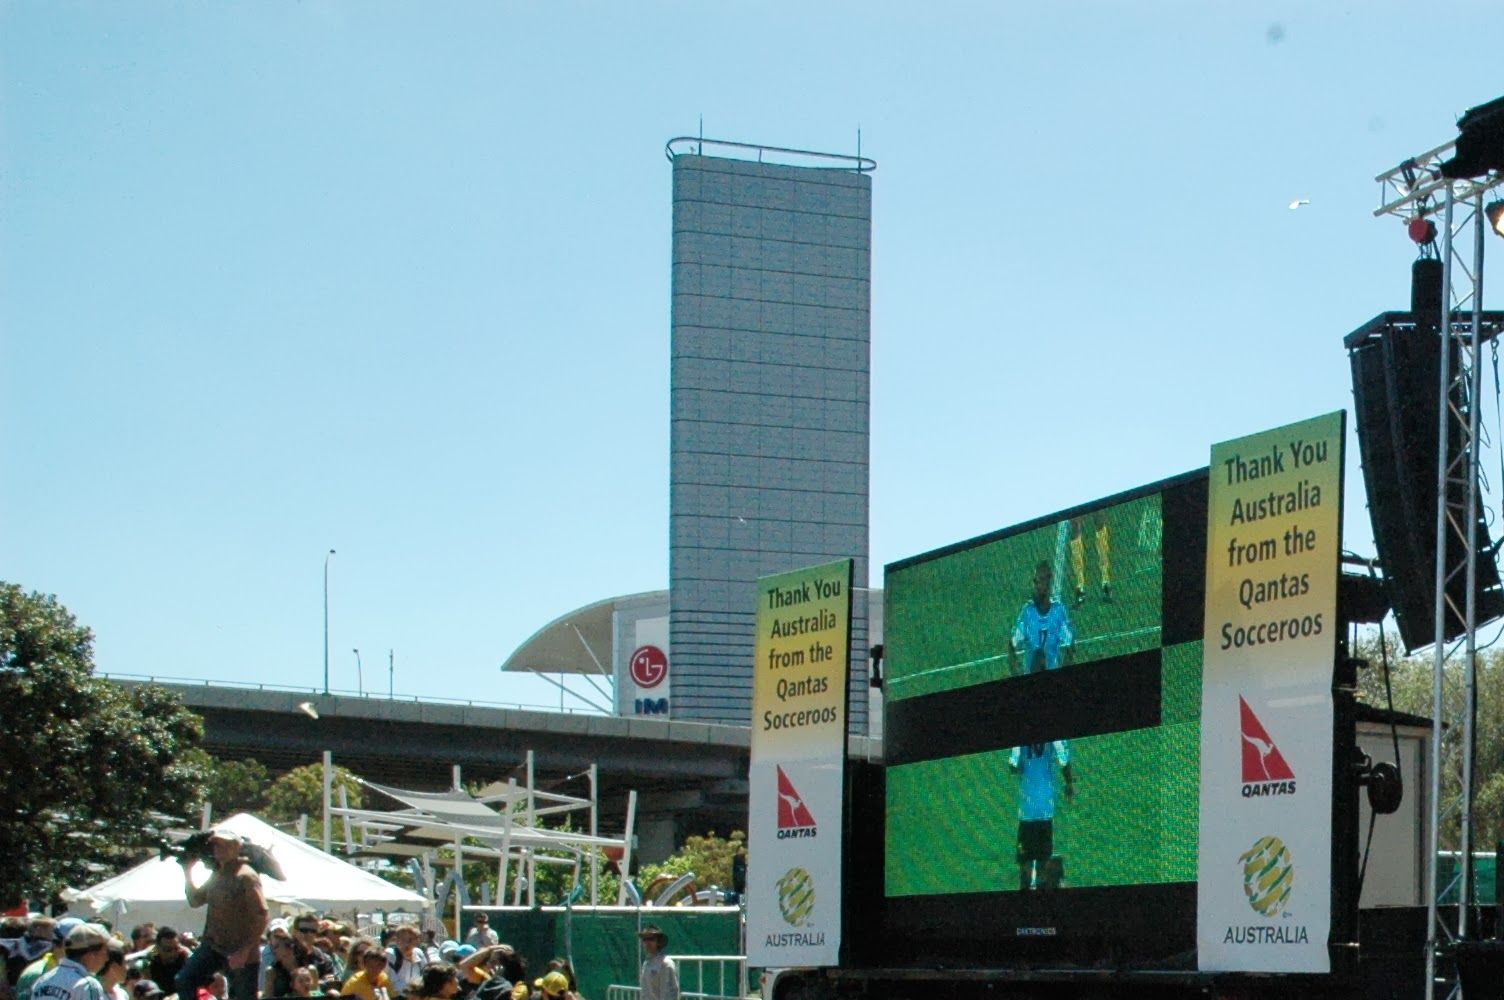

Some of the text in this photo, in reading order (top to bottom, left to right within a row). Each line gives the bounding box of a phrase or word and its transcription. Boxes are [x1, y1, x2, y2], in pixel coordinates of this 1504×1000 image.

[1225, 440, 1328, 486] Thank You
[1230, 480, 1321, 526] Australia
[1228, 525, 1316, 567] from the
[767, 579, 841, 609] Thank You
[1239, 572, 1309, 610] Qantas
[770, 609, 837, 639] Australia
[1221, 613, 1323, 650] Socceroos
[769, 642, 833, 670] from the
[776, 676, 828, 701] Qantas
[764, 706, 837, 731] Socceroos
[1242, 781, 1296, 798] QANTAS
[777, 827, 817, 840] QANTAS
[765, 933, 825, 947] AUSTRALIA
[1223, 926, 1309, 944] AUSTRALIA
